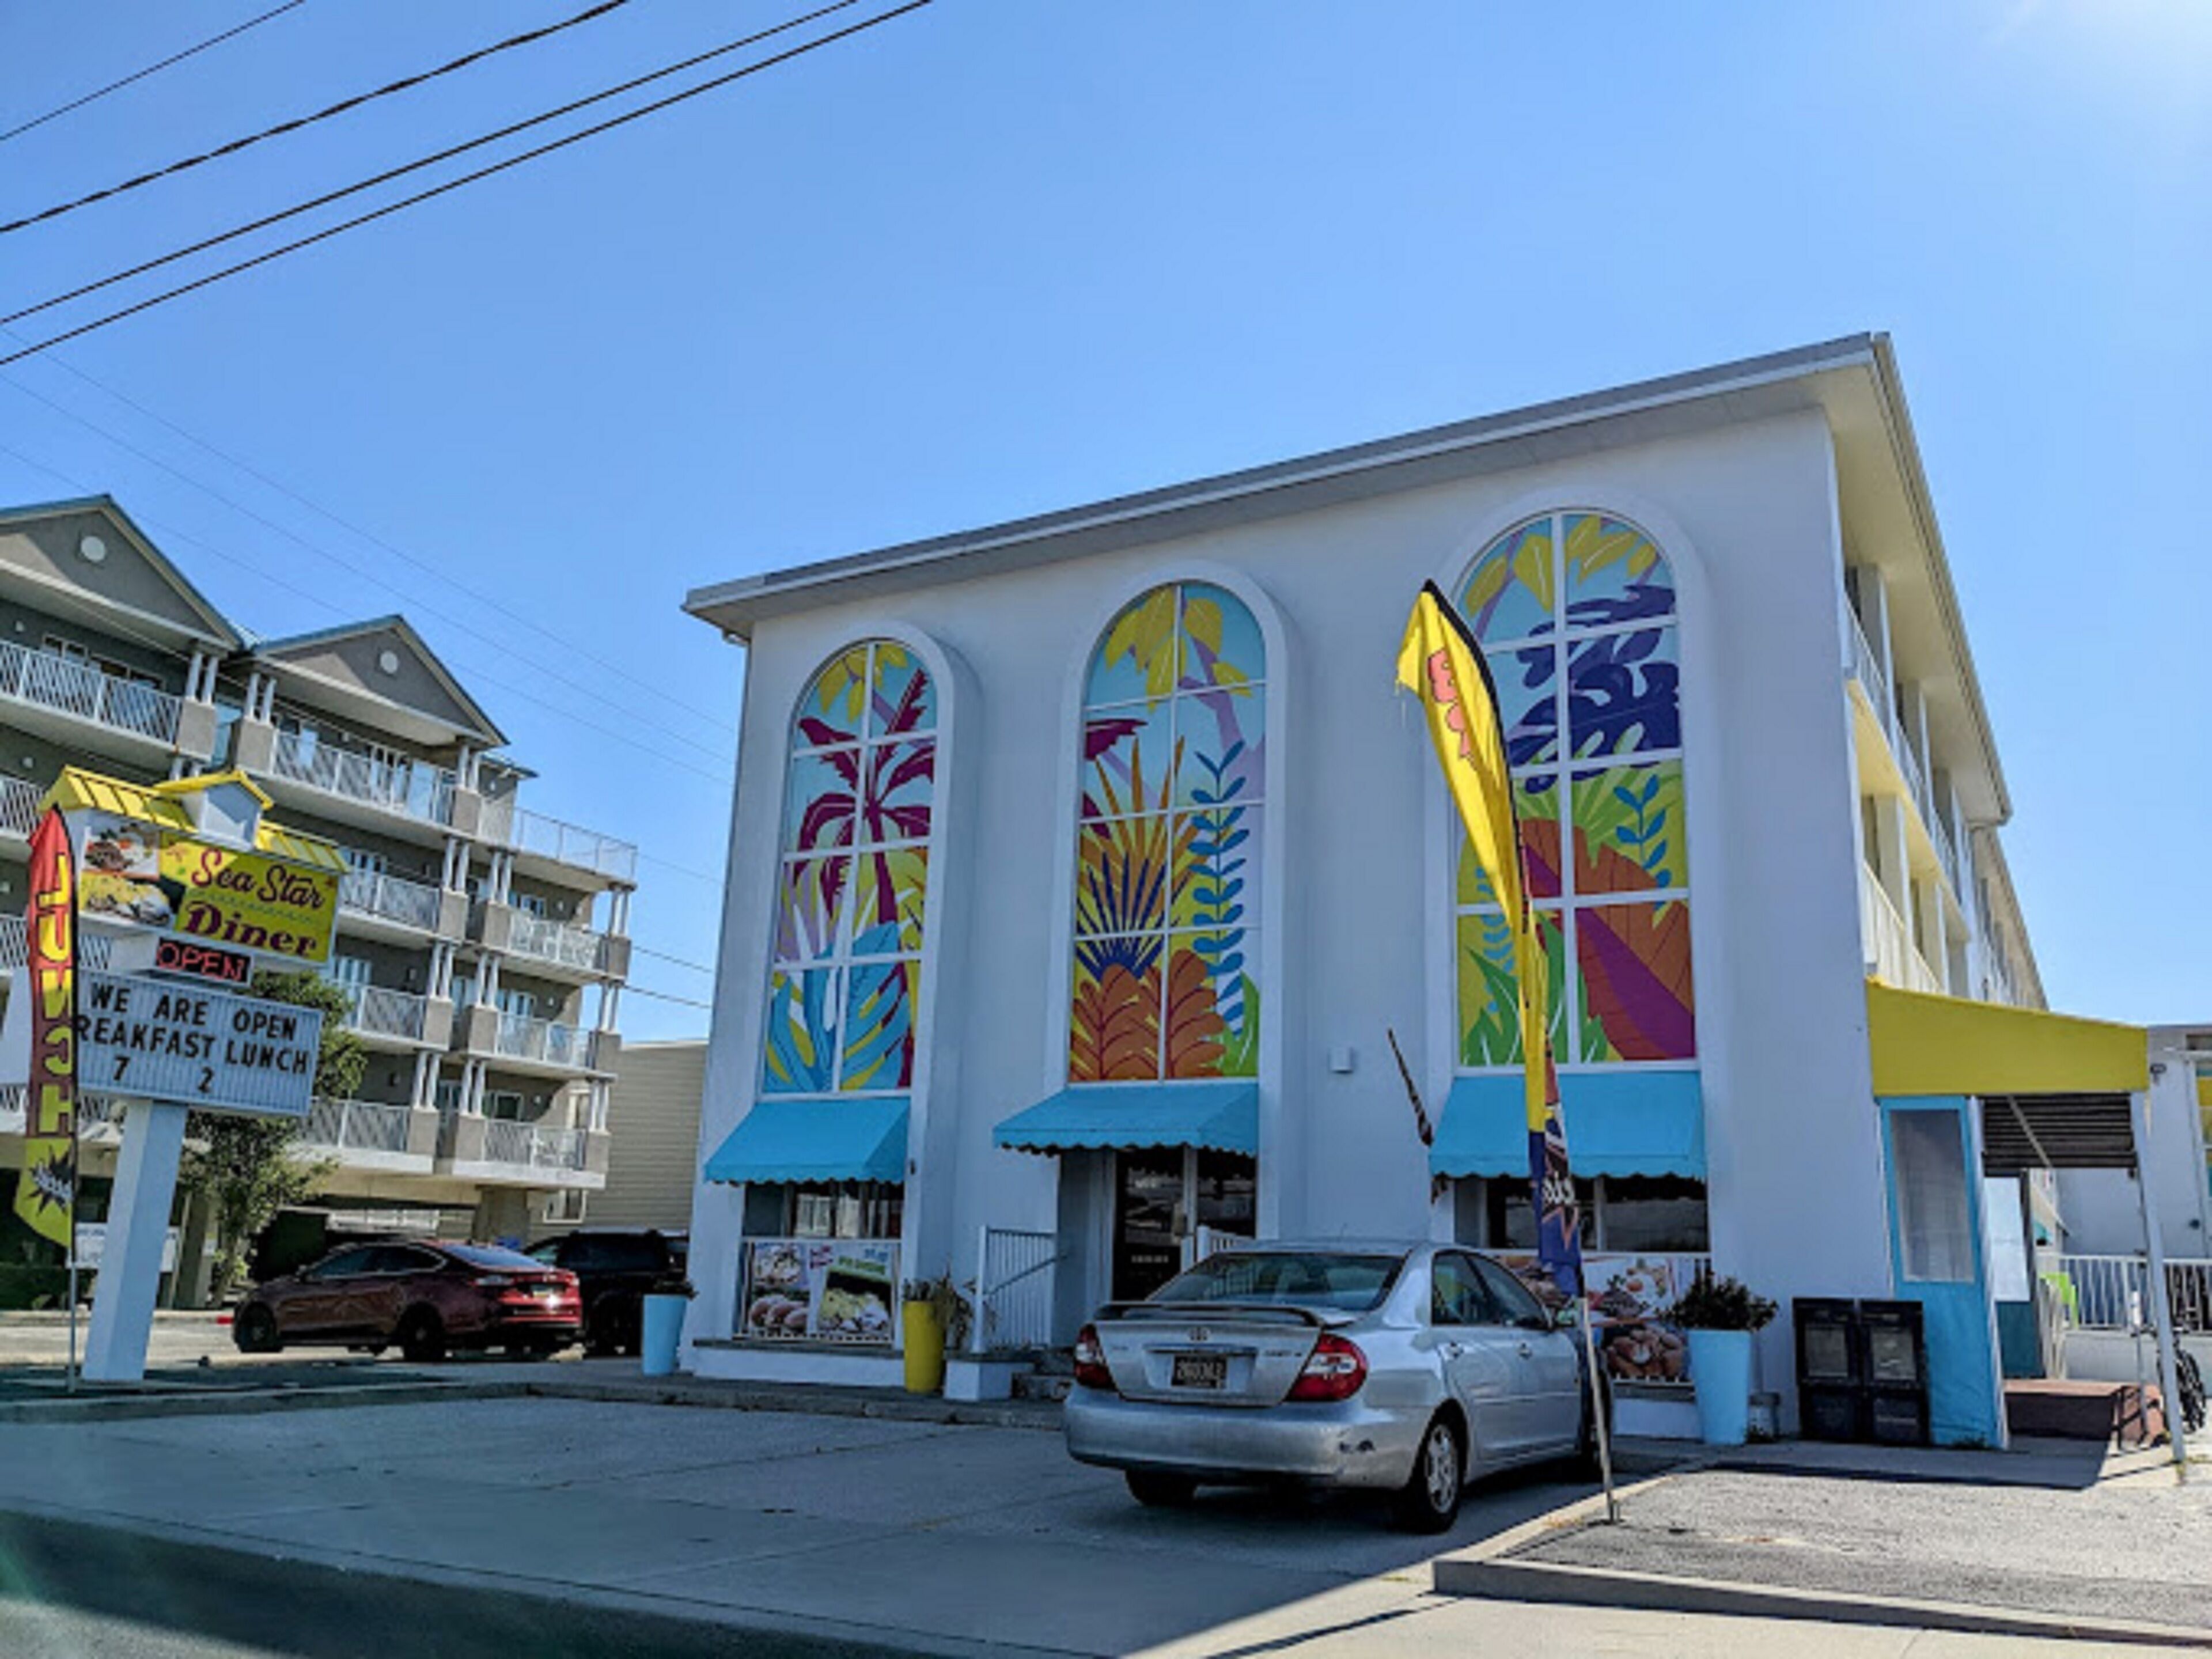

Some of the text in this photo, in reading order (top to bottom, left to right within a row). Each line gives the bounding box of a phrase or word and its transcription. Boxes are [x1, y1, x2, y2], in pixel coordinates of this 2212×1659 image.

[191, 847, 324, 909] Sea Star
[183, 900, 316, 956] Diner
[156, 942, 245, 980] OPEN
[90, 982, 297, 1040] WE ARE OPEN
[77, 1014, 310, 1074] REAKFAST LUNCH
[113, 1056, 214, 1093] 7 2
